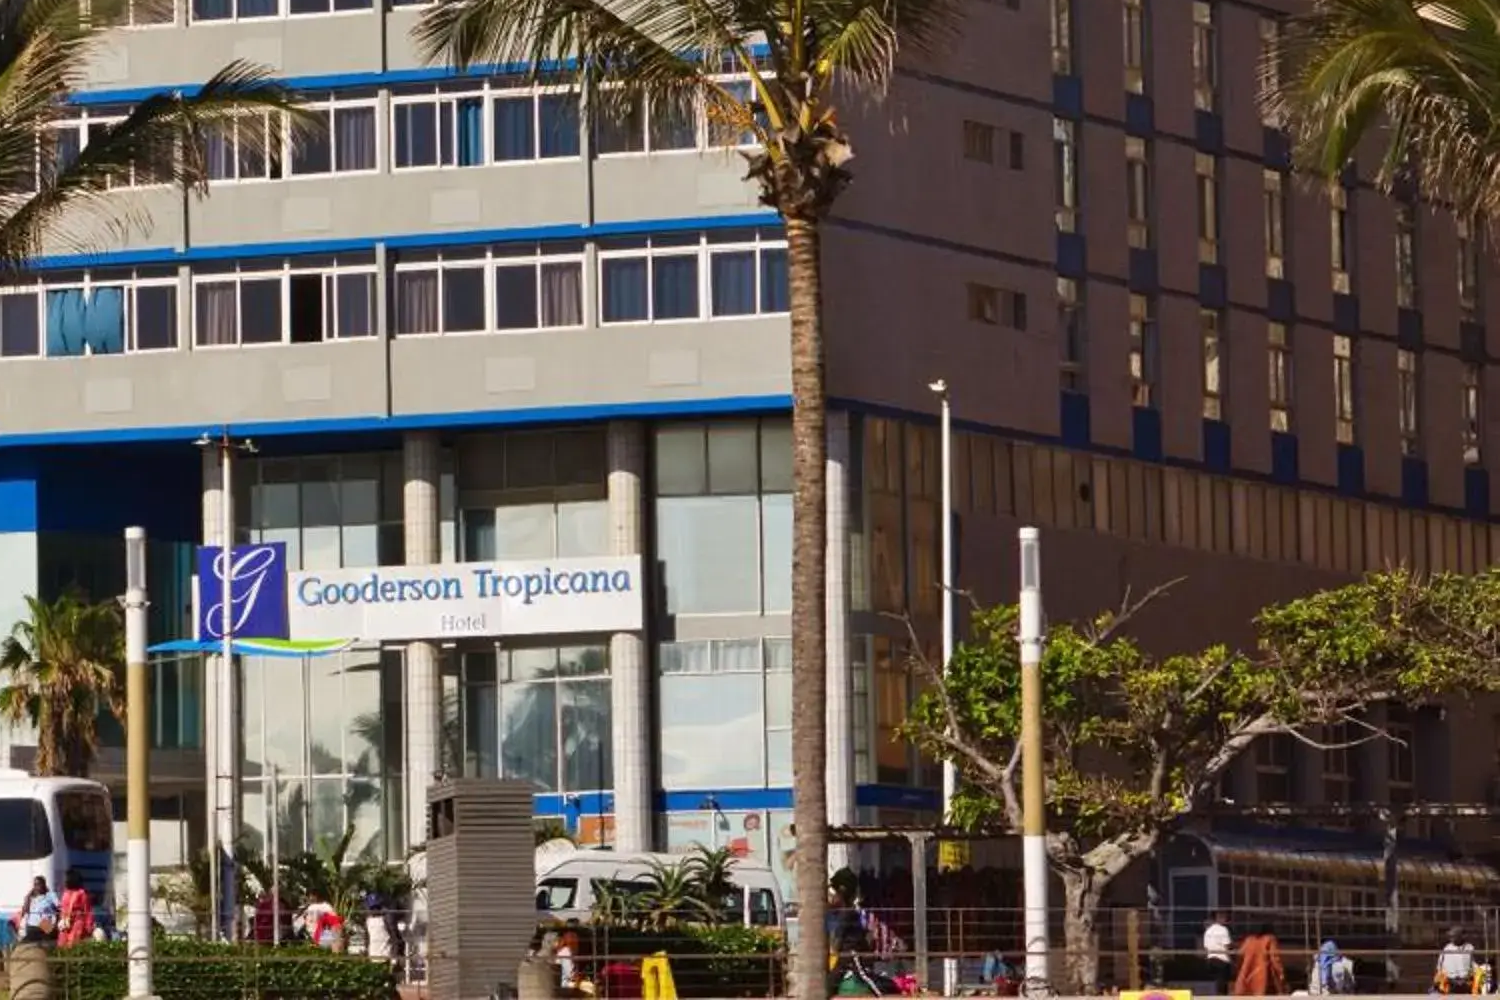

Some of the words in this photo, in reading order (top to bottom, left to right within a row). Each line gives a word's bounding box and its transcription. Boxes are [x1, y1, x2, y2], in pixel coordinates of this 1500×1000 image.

[297, 574, 464, 607] Gooderson
[473, 567, 632, 605] Tropicana
[441, 613, 486, 631] Hotel
